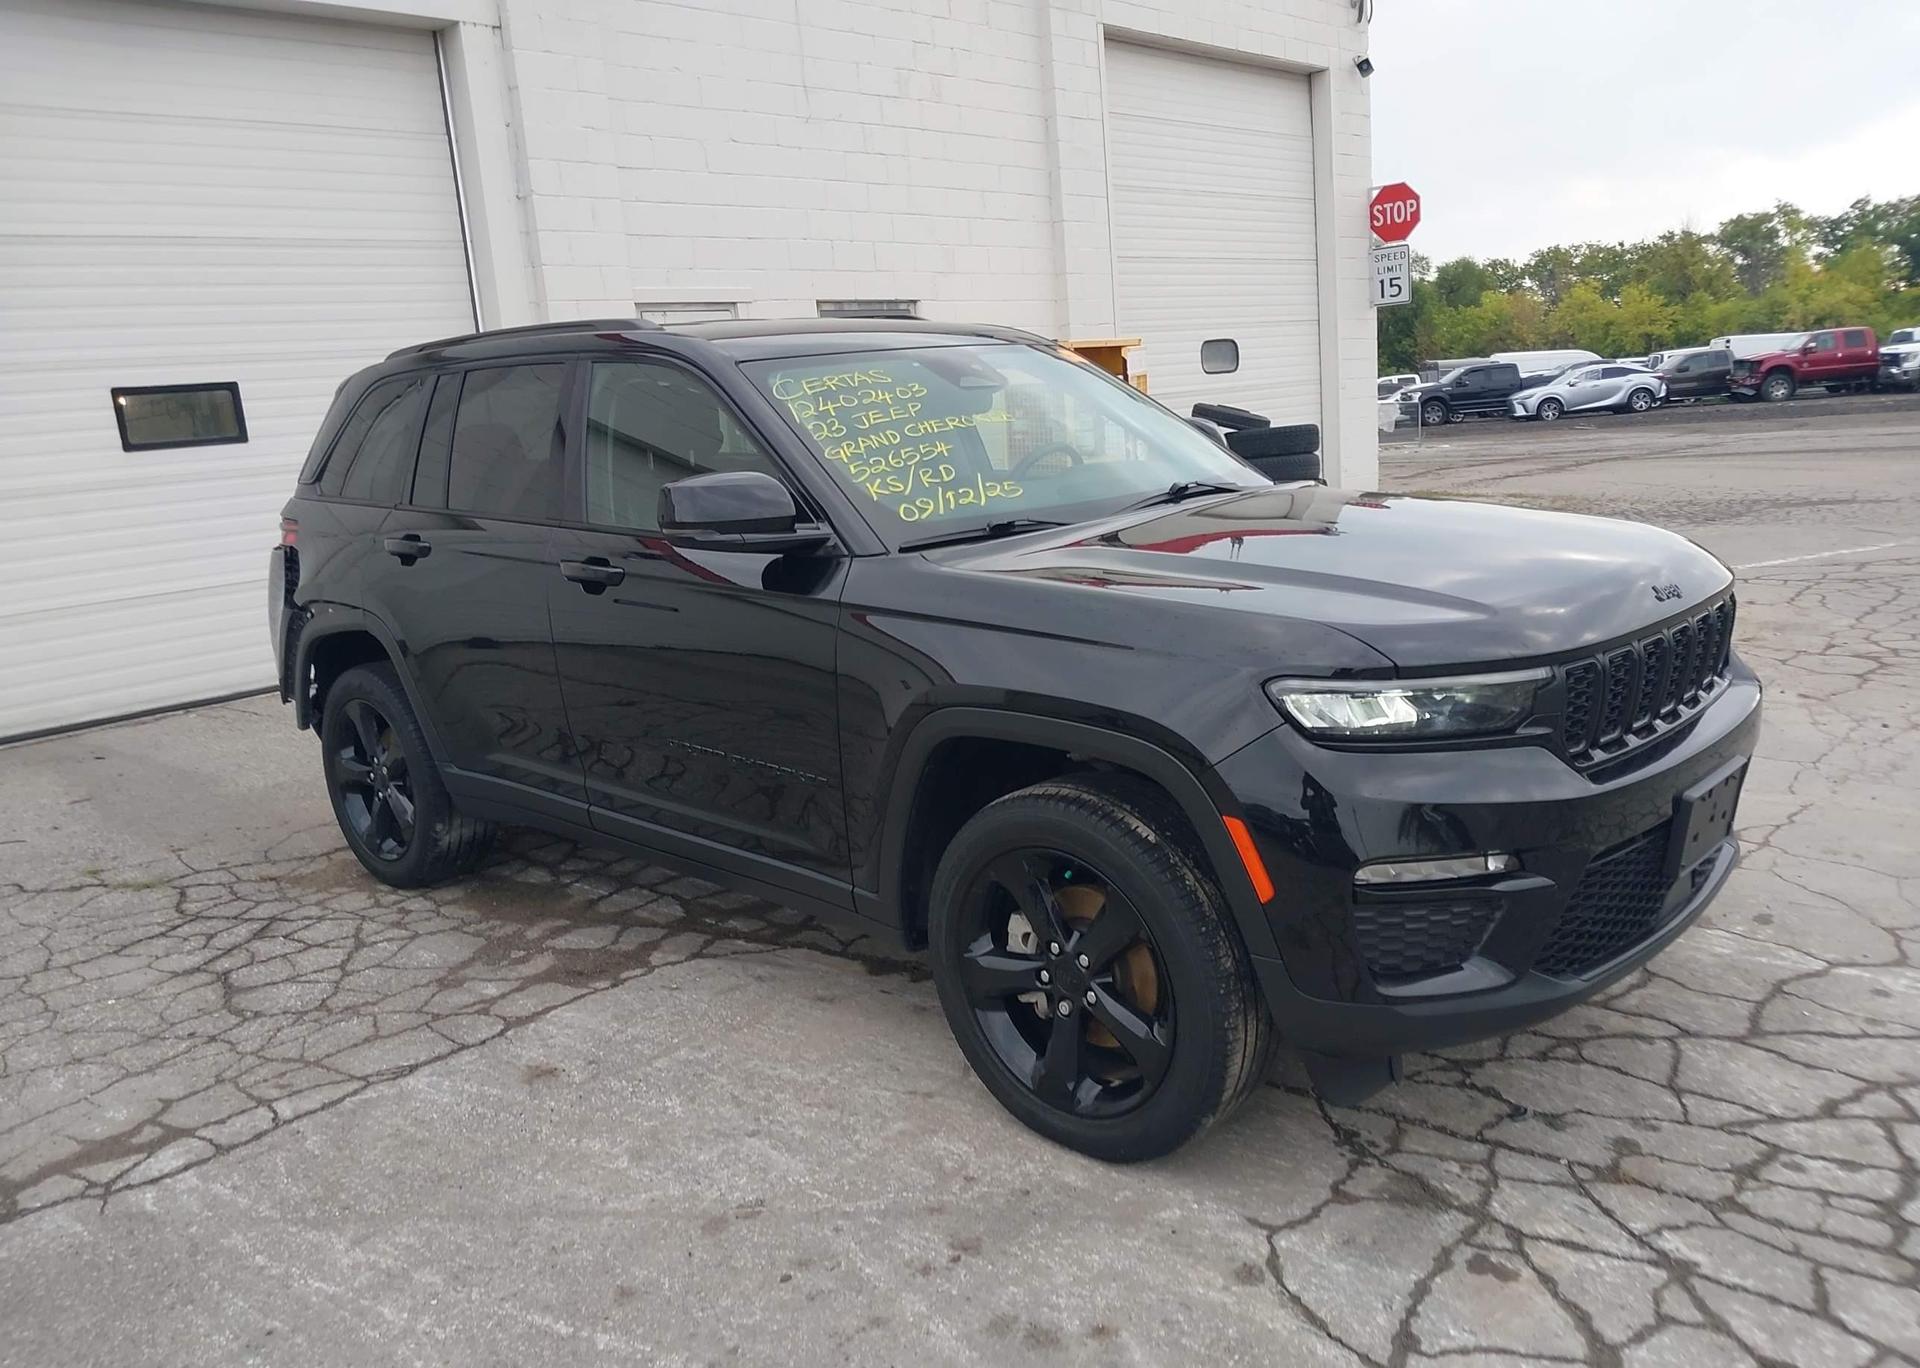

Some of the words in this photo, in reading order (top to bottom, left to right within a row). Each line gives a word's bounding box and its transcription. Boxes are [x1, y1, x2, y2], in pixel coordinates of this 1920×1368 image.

[1373, 199, 1417, 227] STOP
[1374, 251, 1406, 264] SPEED
[1377, 263, 1404, 275] LIMIT
[1379, 276, 1402, 299] 15
[773, 370, 892, 400] CERTAS
[787, 383, 927, 423] 12402403
[807, 418, 847, 441] 23
[852, 402, 922, 429] JEEP
[824, 430, 900, 463] GRAND
[904, 410, 1017, 437] CHEROE
[850, 441, 954, 484] 526554
[900, 473, 1023, 521] 09/12/25
